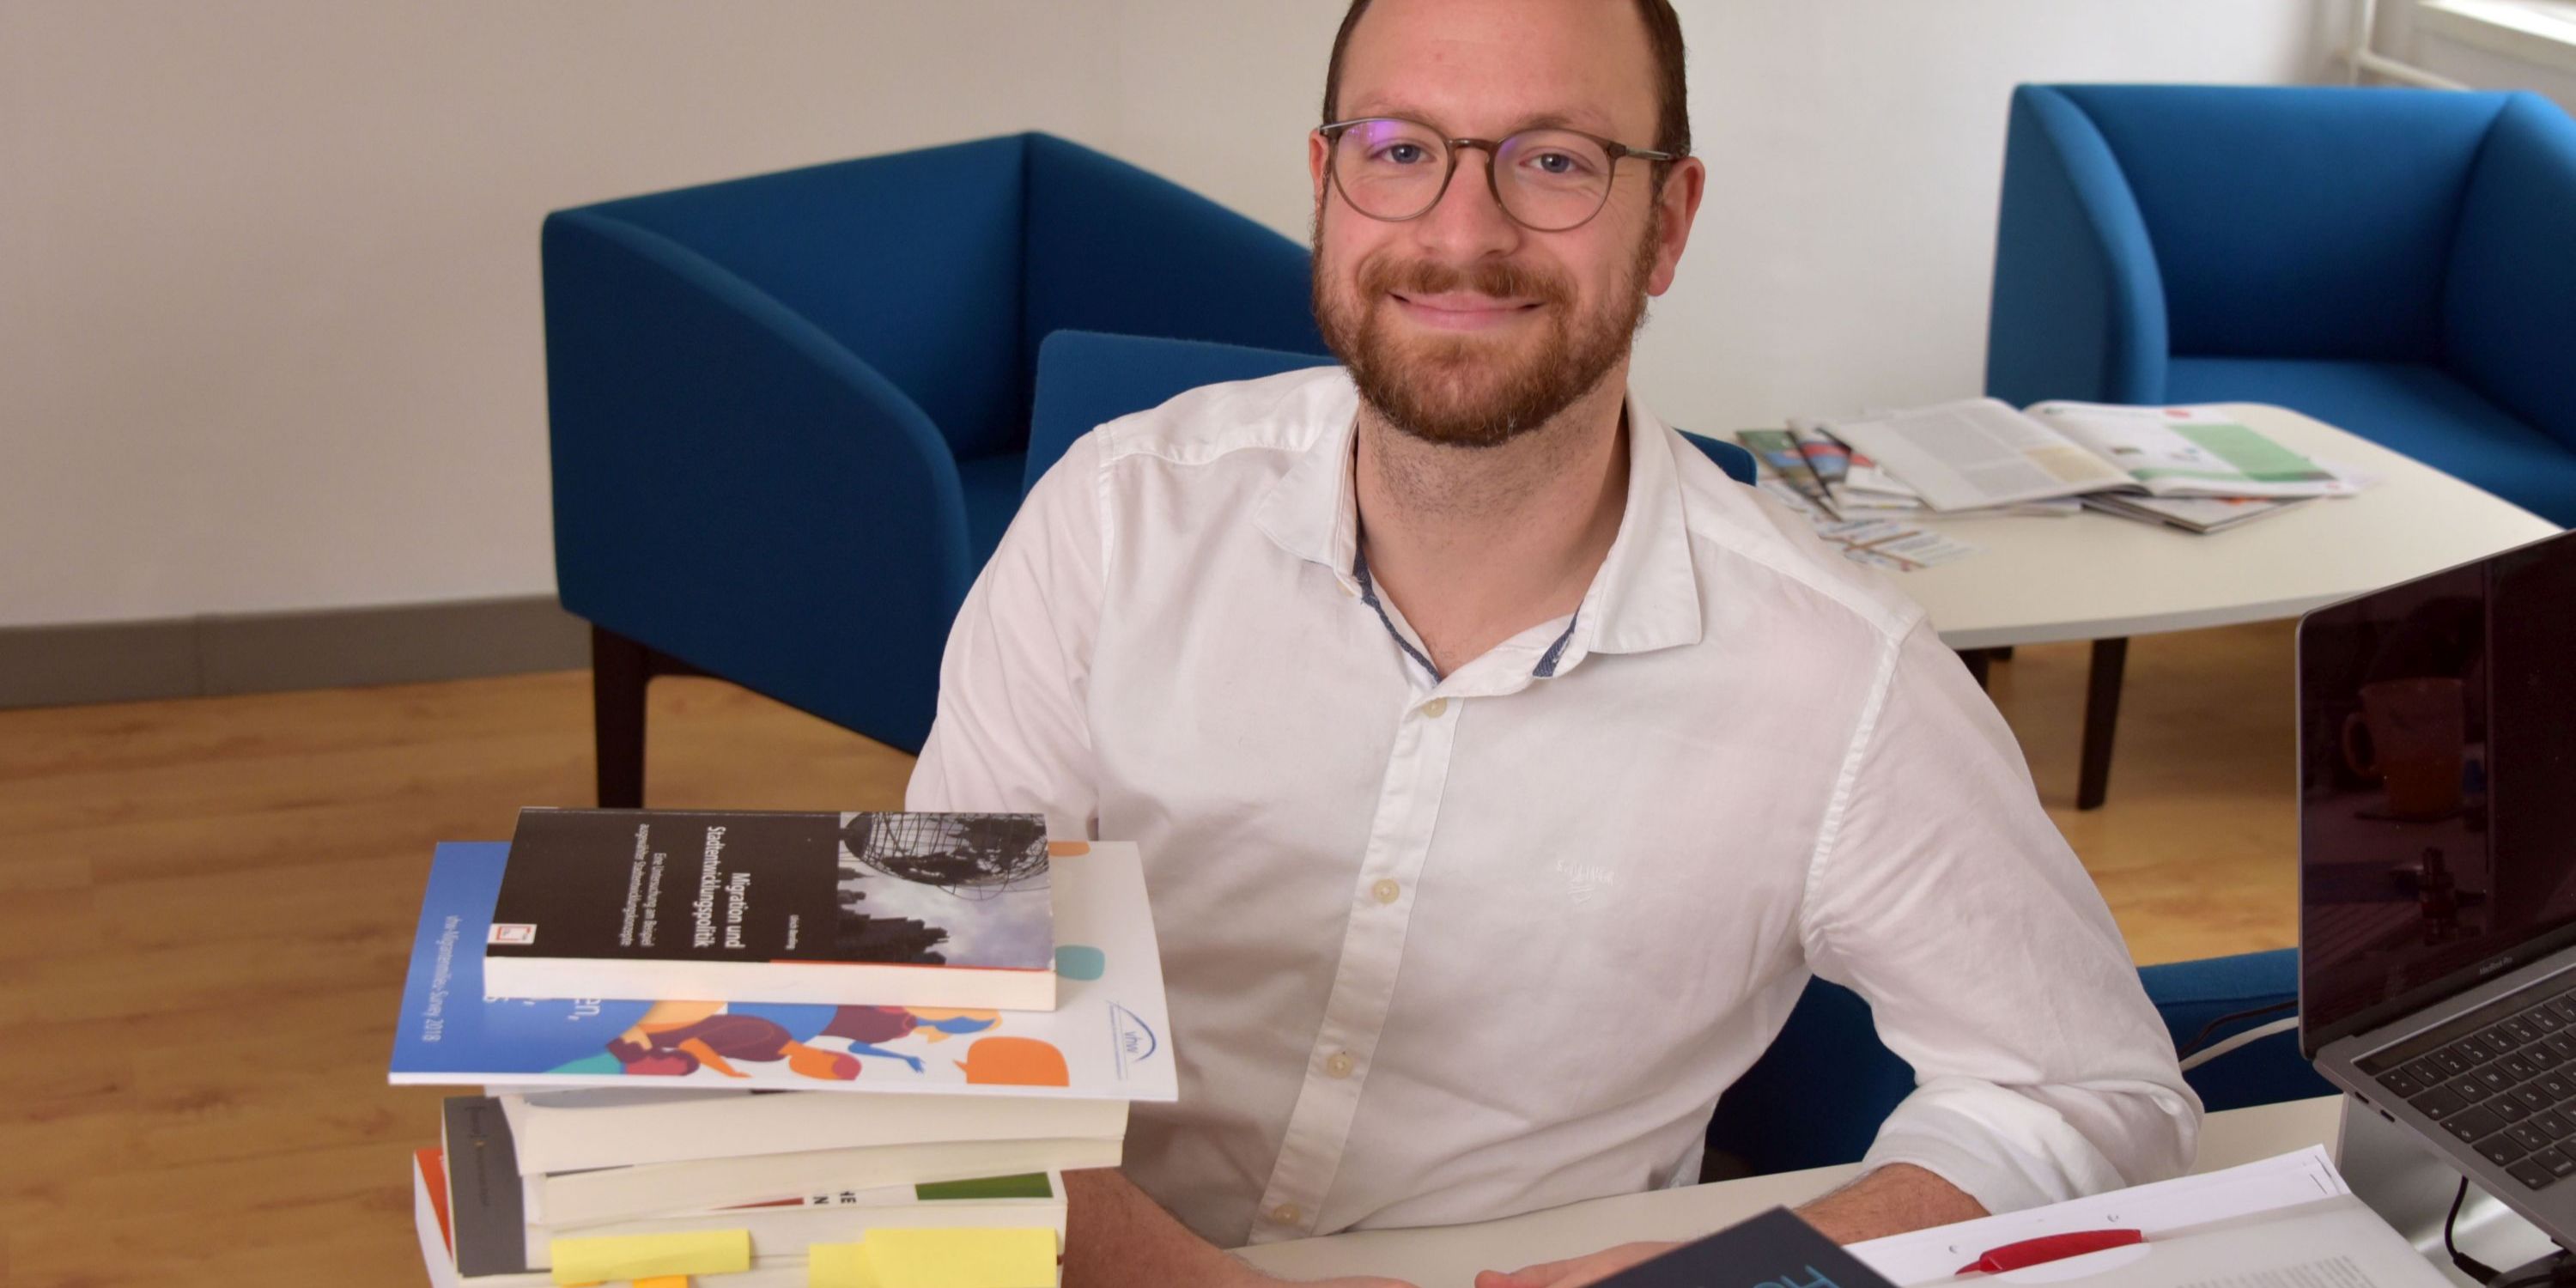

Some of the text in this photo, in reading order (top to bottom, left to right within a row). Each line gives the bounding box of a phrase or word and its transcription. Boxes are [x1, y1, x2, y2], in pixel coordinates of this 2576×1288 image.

[618, 861, 647, 946] Stadtentwicklungskonzepte
[639, 853, 667, 946] Eine Untersuchung am Beispiel
[691, 826, 726, 948] Stadtentwicklungspolitik
[724, 872, 751, 948] Migration und
[421, 1018, 444, 1042] 2018
[1124, 1031, 1143, 1054] vhw
